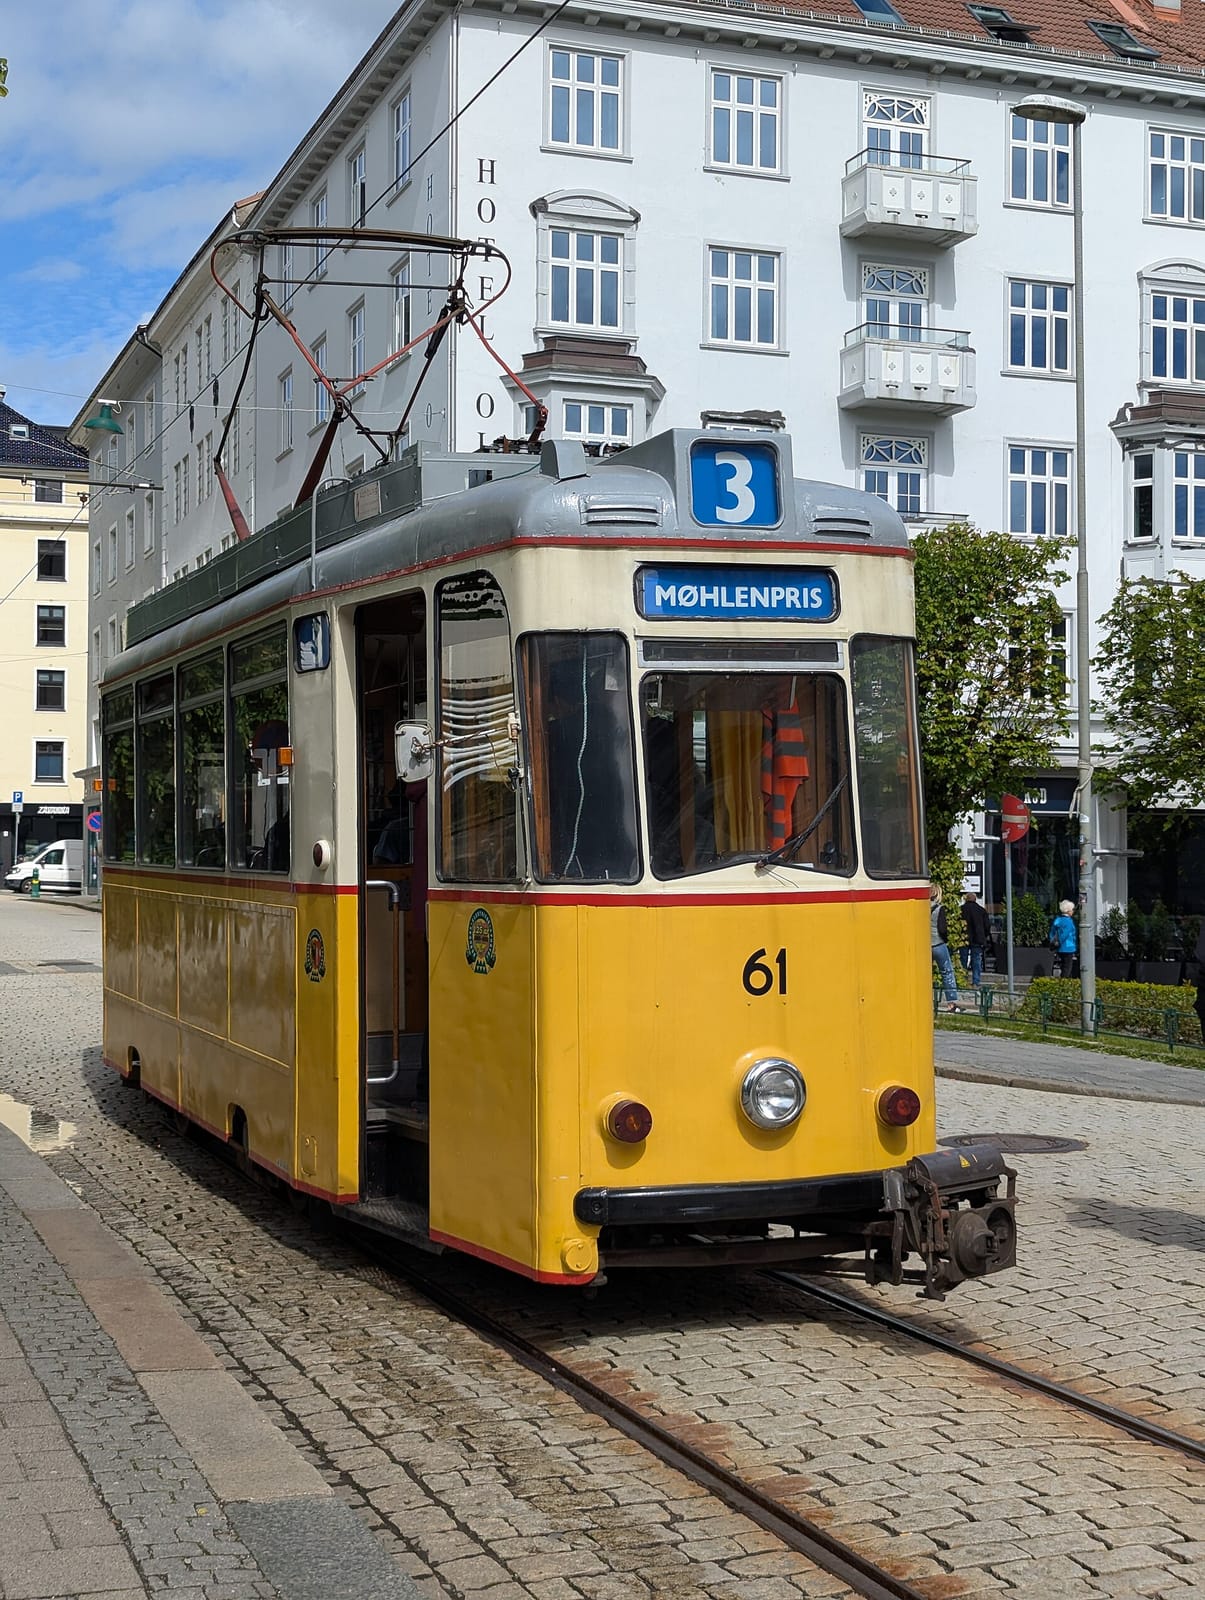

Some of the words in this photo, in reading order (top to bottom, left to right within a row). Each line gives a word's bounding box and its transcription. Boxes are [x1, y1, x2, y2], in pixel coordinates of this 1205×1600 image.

[476, 157, 498, 341] HOTEL
[715, 451, 756, 523] 3
[655, 584, 823, 609] MØHLENPRIS
[742, 947, 787, 997] 61
